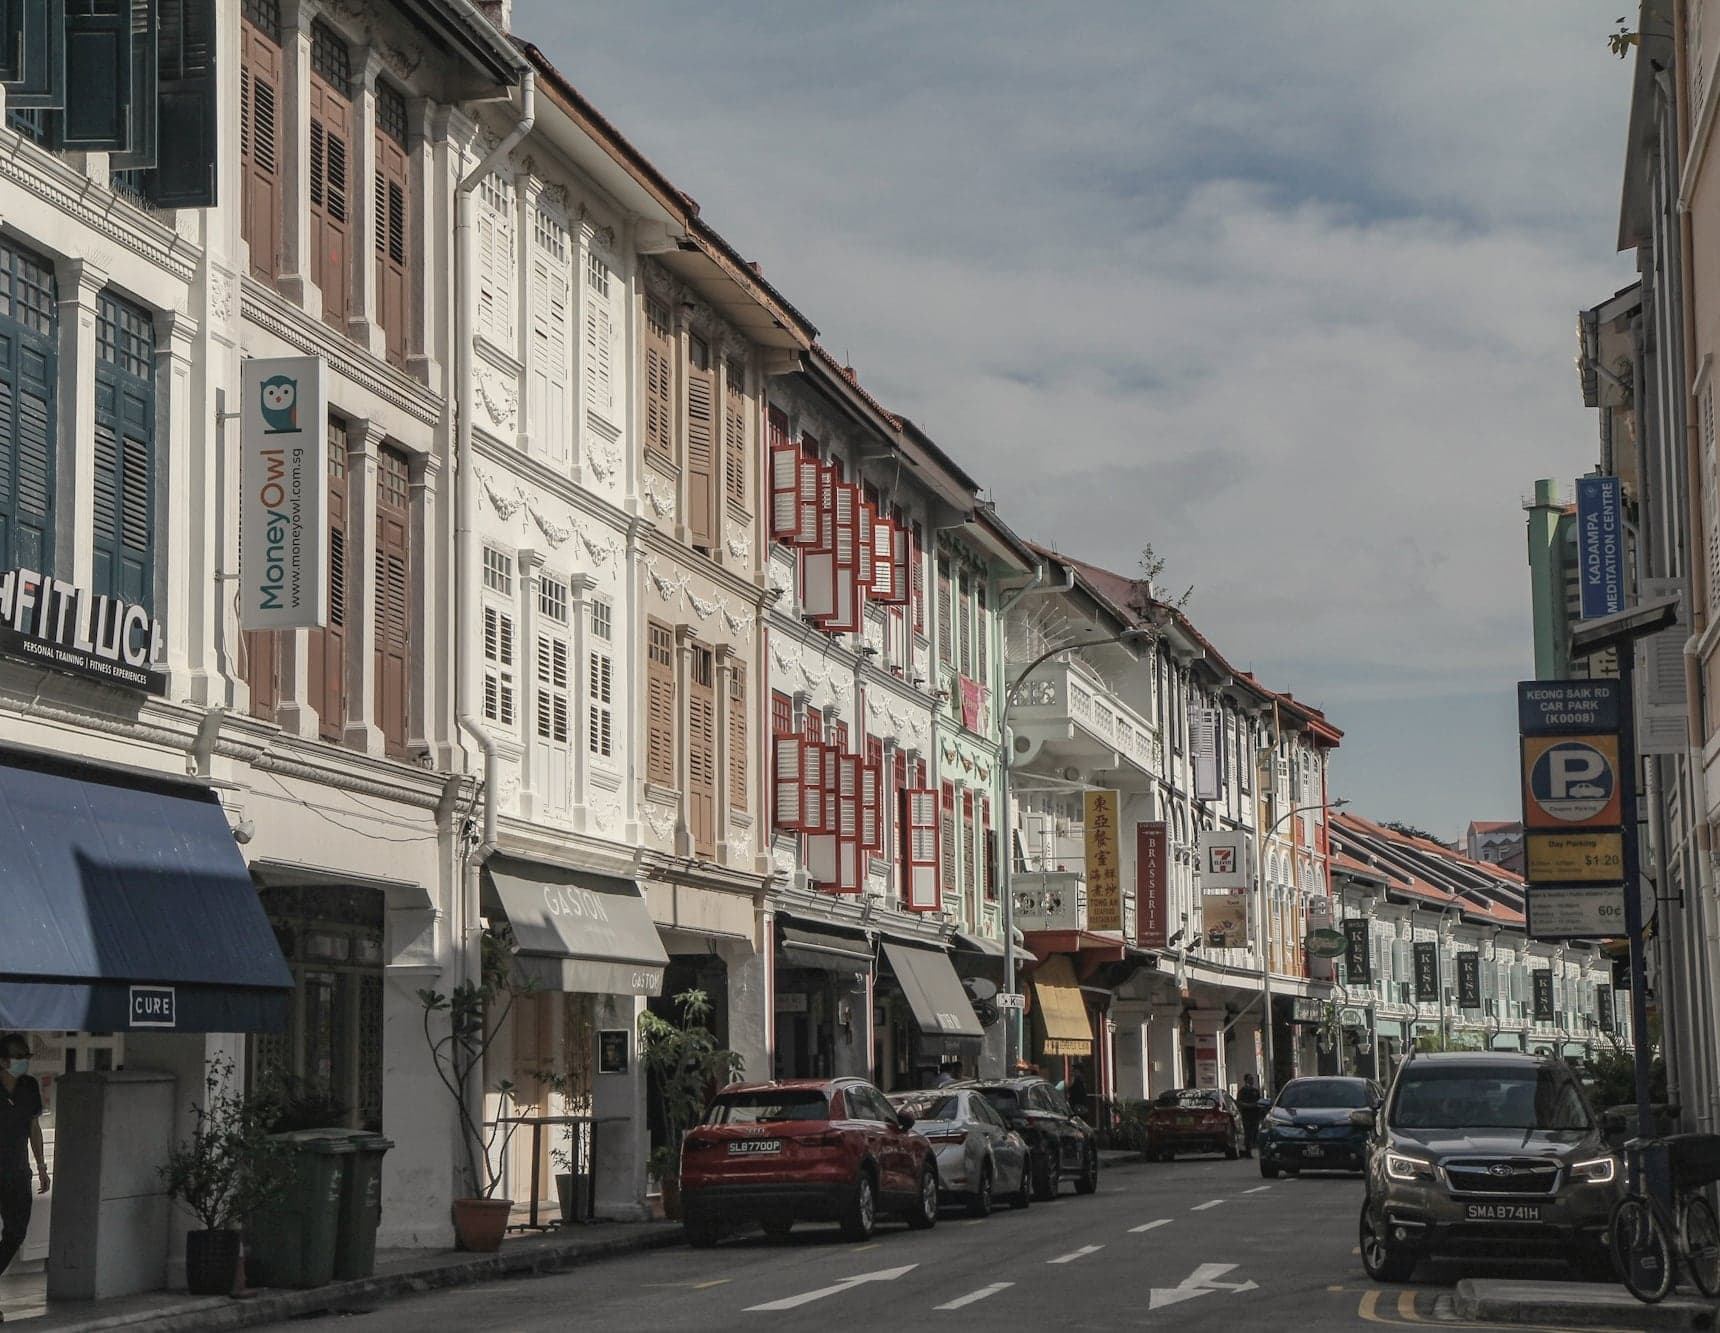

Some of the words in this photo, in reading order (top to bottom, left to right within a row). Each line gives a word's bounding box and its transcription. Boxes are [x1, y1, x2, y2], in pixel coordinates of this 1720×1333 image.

[1602, 482, 1615, 531] CENTRE
[260, 449, 290, 609] MoneyOwl
[290, 448, 303, 608] www.moneyowl.com.sg
[1586, 512, 1600, 585] KADAMPA
[1603, 534, 1618, 614] MEDITATION
[23, 640, 54, 659] PERSONAL
[56, 650, 84, 667] TRAINING
[90, 660, 112, 675] FITNESS
[113, 667, 147, 685] EXPERIENCES
[1526, 689, 1563, 700] KEONG
[1567, 688, 1592, 698] SAIK
[1594, 688, 1610, 698] RD
[1540, 702, 1563, 711] CAR
[1567, 701, 1600, 711] PARK
[1549, 750, 1604, 798] P
[1215, 850, 1231, 860] 7
[1566, 840, 1597, 848] Parking
[1148, 838, 1156, 929] BRASSERIE
[544, 886, 609, 922] GASTON
[136, 997, 169, 1014] CURE
[729, 1141, 780, 1152] SLB7700P
[1468, 1205, 1539, 1219] SMA8741H
